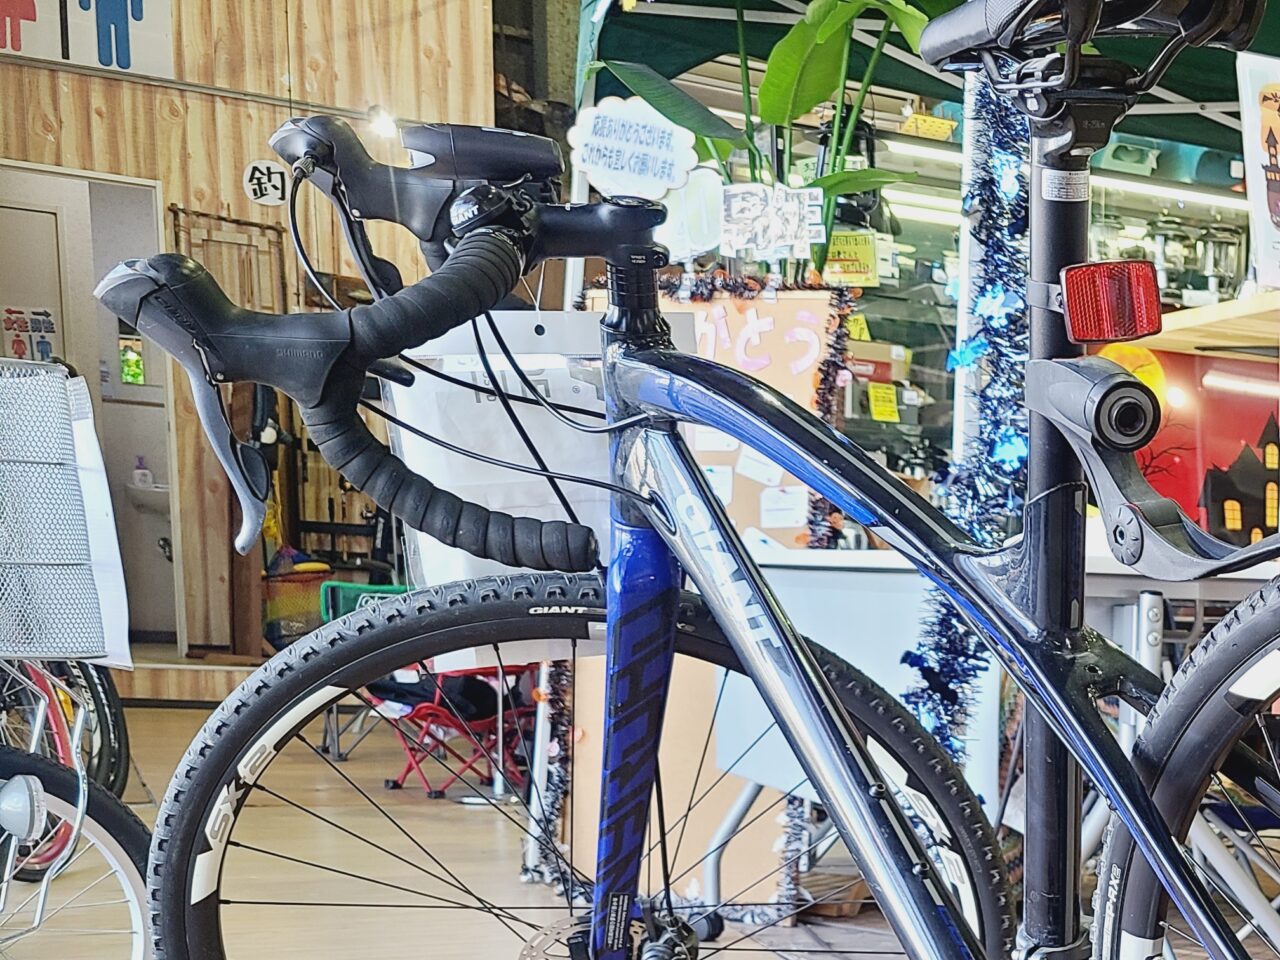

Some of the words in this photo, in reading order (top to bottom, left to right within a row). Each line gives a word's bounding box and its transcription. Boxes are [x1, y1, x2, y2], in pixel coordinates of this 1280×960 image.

[248, 166, 286, 201] 釣
[529, 605, 588, 615] GIANT
[209, 743, 267, 844] SX-2
